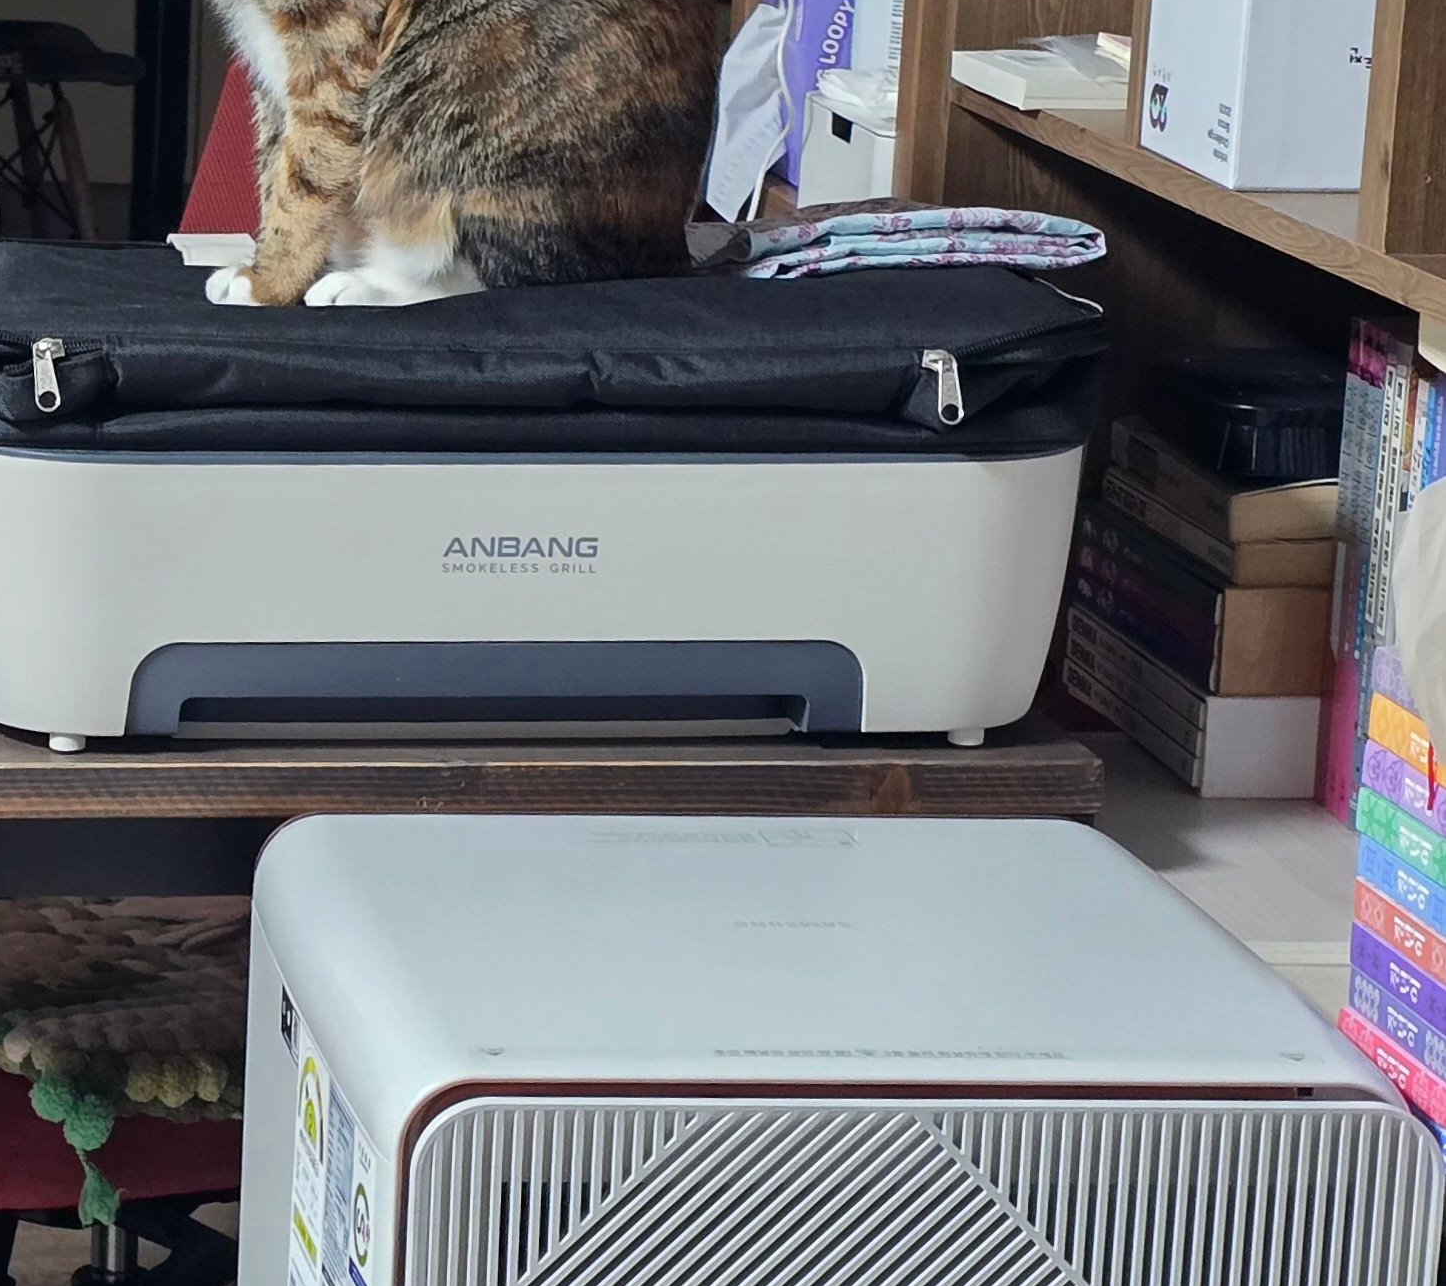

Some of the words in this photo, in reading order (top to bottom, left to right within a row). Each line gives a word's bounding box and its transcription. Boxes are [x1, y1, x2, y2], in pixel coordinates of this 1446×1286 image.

[818, 0, 855, 65] LOOPY
[443, 536, 599, 558] ANBANG
[441, 563, 540, 574] SMOKELESS
[549, 563, 597, 574] GRILL
